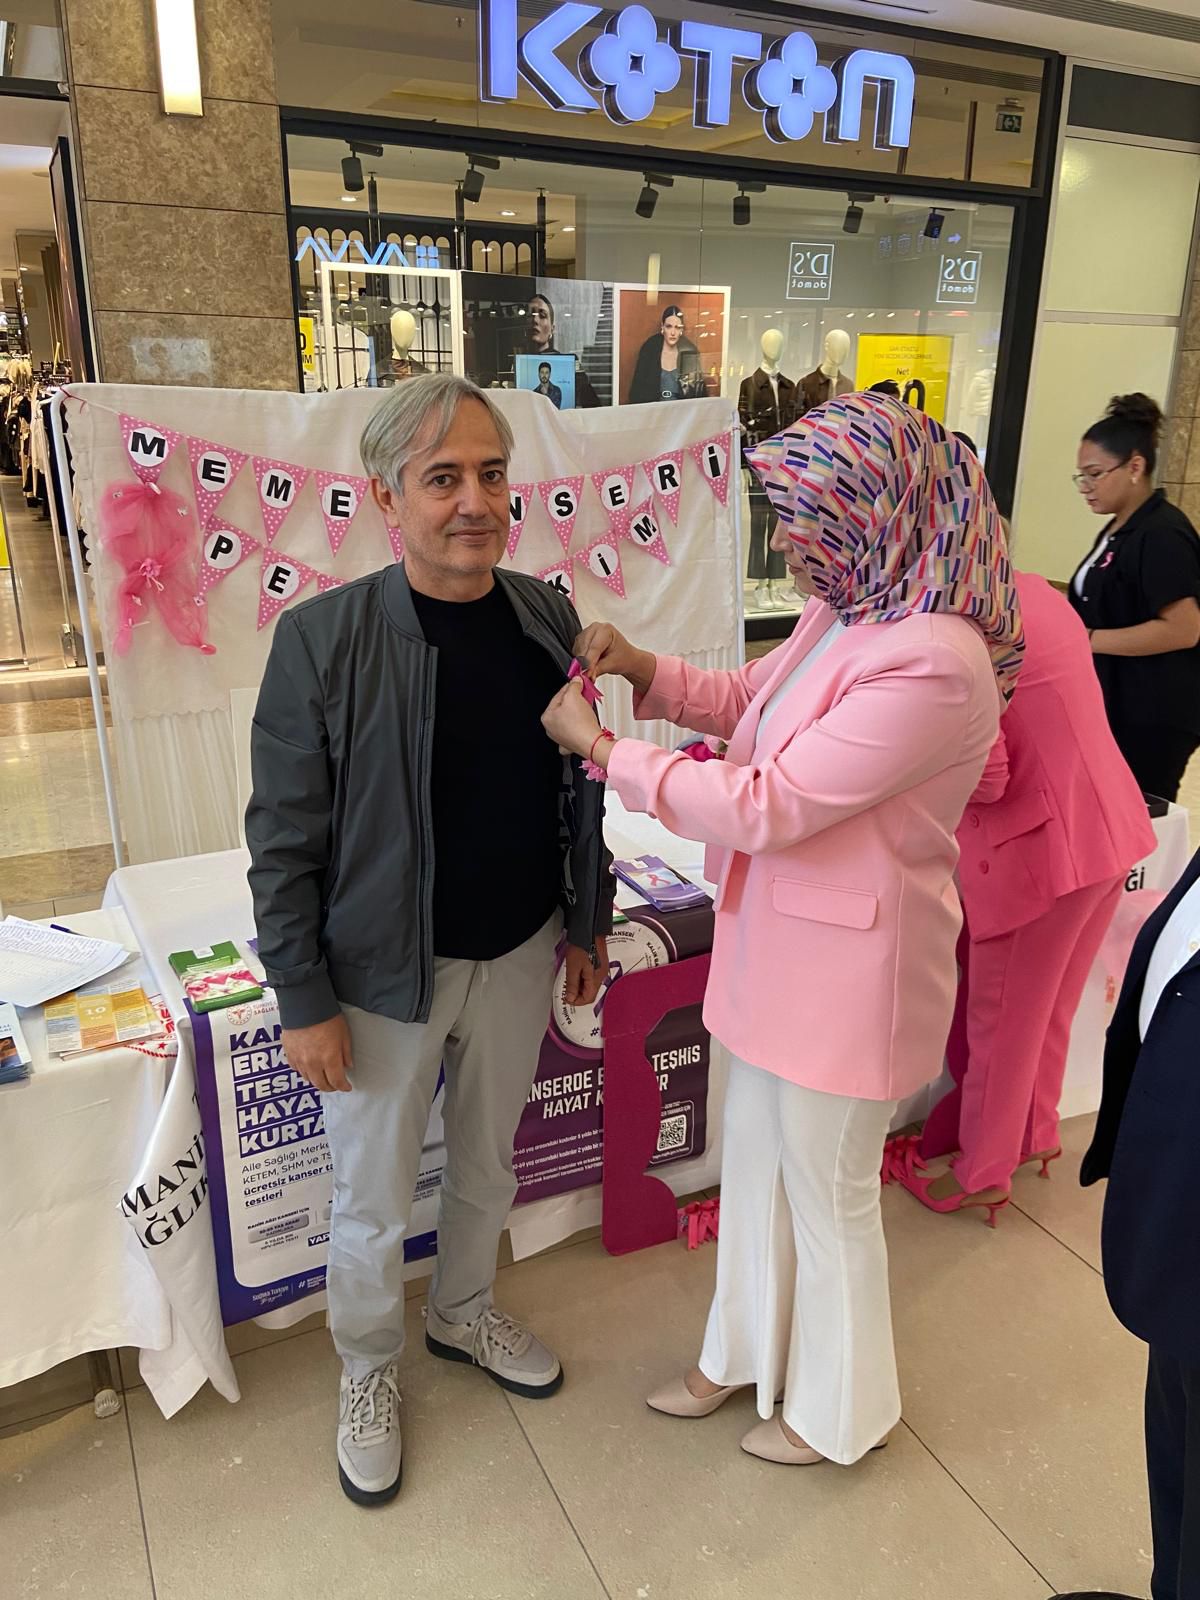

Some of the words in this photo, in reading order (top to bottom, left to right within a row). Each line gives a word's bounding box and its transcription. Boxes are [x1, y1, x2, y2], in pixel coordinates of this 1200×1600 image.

[131, 431, 351, 518] MEME
[233, 1048, 288, 1077] ERK
[238, 1091, 320, 1129] HAYA
[543, 1092, 592, 1119] HAYAT
[241, 1116, 325, 1155] KURTA
[282, 1160, 304, 1173] SHM
[307, 1157, 319, 1165] ve
[244, 1177, 287, 1196] ücretsiz
[288, 1166, 323, 1182] kanser
[245, 1189, 283, 1207] testleri
